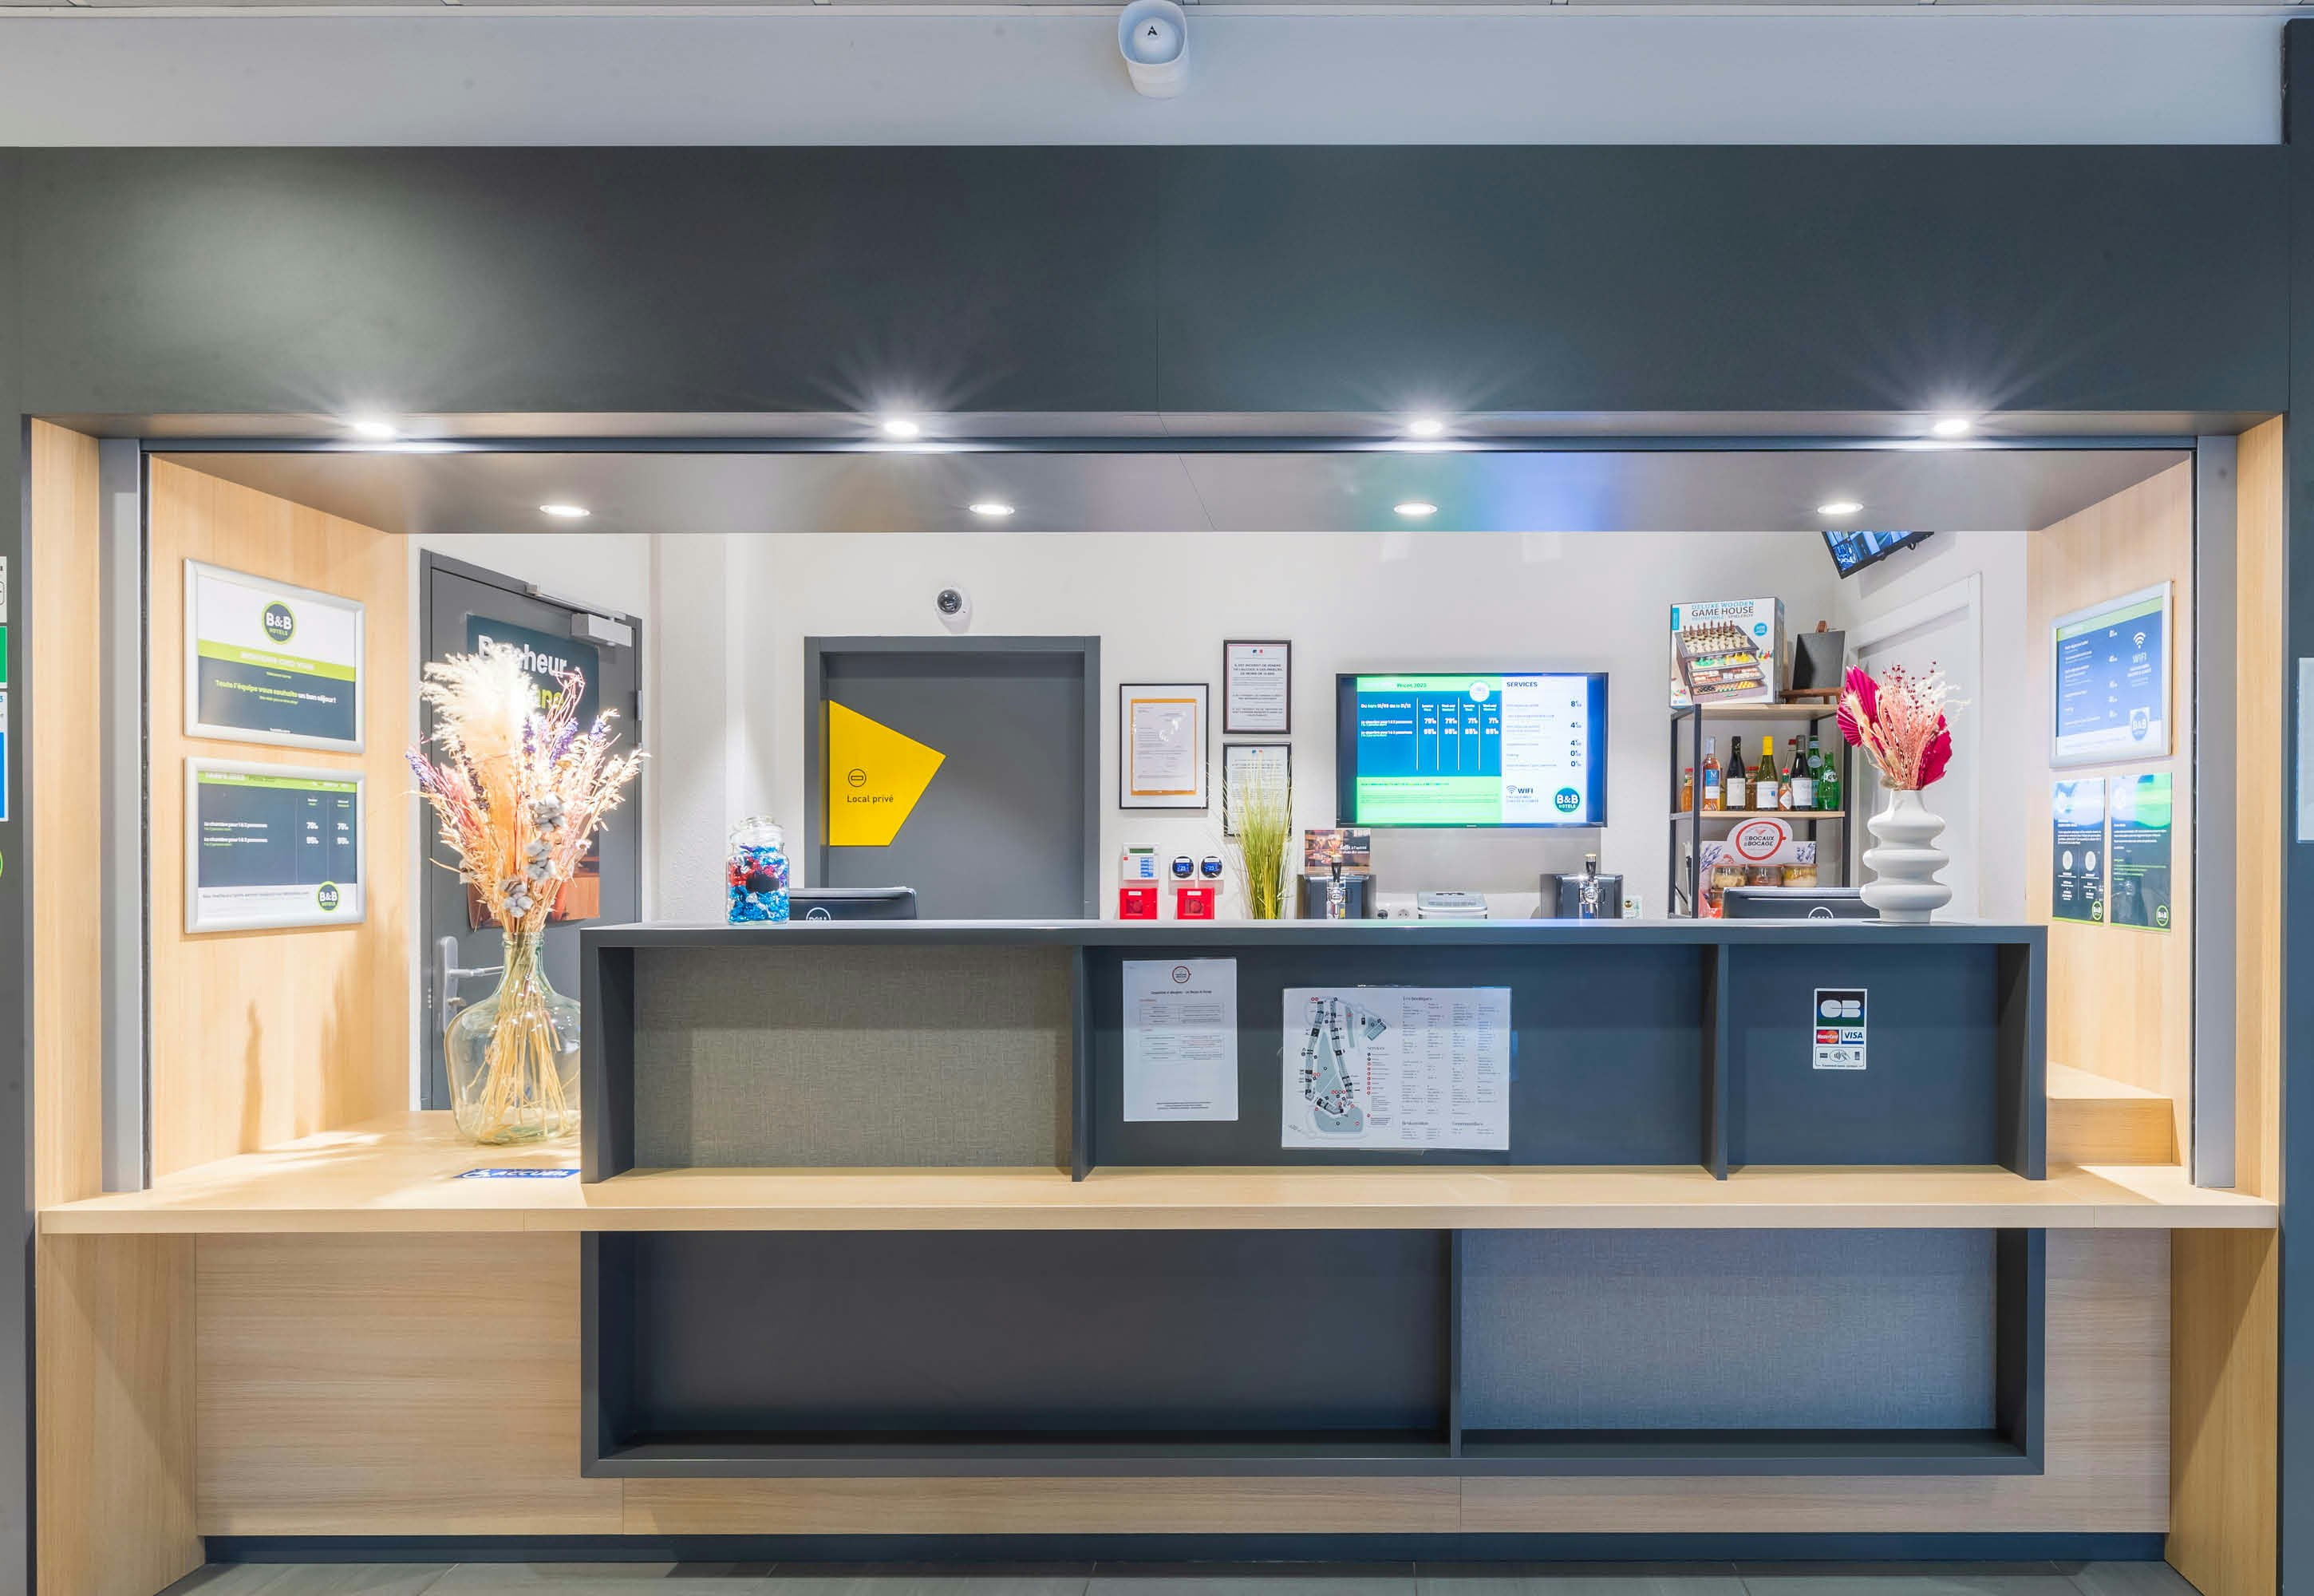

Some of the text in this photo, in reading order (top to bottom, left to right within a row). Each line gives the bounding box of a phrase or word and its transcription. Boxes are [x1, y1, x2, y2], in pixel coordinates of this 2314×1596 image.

[1692, 606, 1754, 616] GAME HOUSE
[266, 612, 292, 630] B&B
[479, 634, 567, 678] Bheur
[873, 794, 894, 804] privé
[1557, 794, 1578, 804] B&B
[320, 891, 337, 902] B&B
[1821, 1000, 1861, 1018] CB
